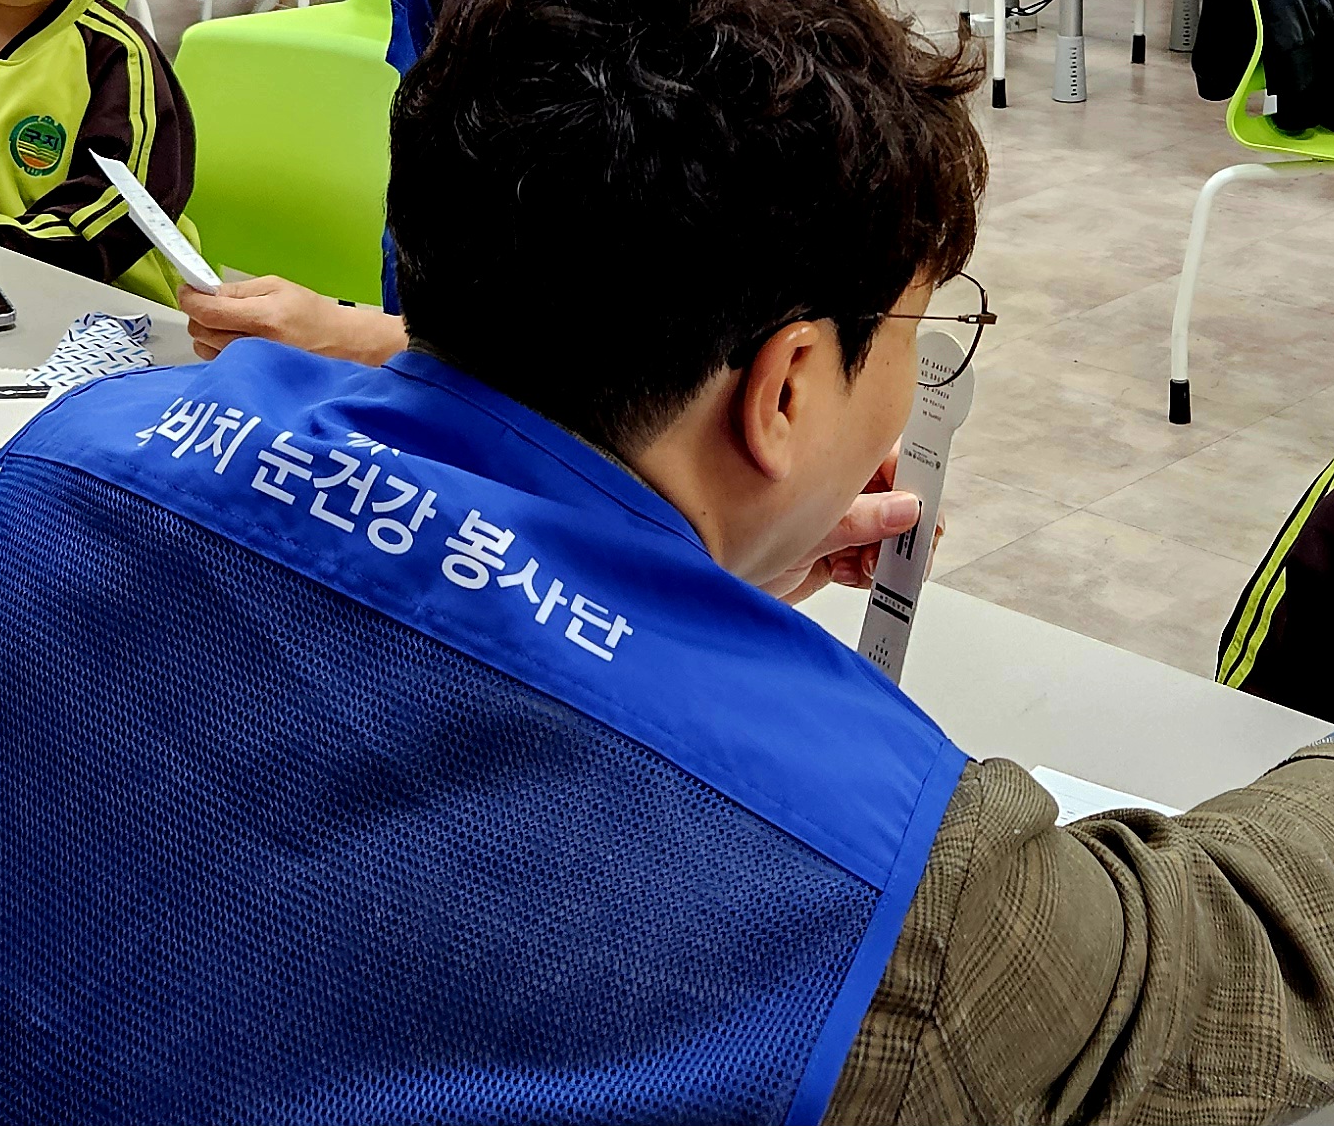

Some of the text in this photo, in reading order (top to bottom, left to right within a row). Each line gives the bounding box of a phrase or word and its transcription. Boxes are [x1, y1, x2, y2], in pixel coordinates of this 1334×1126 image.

[25, 127, 60, 151] 구지
[252, 431, 437, 555] 눈건강
[441, 509, 634, 662] 봉사단
